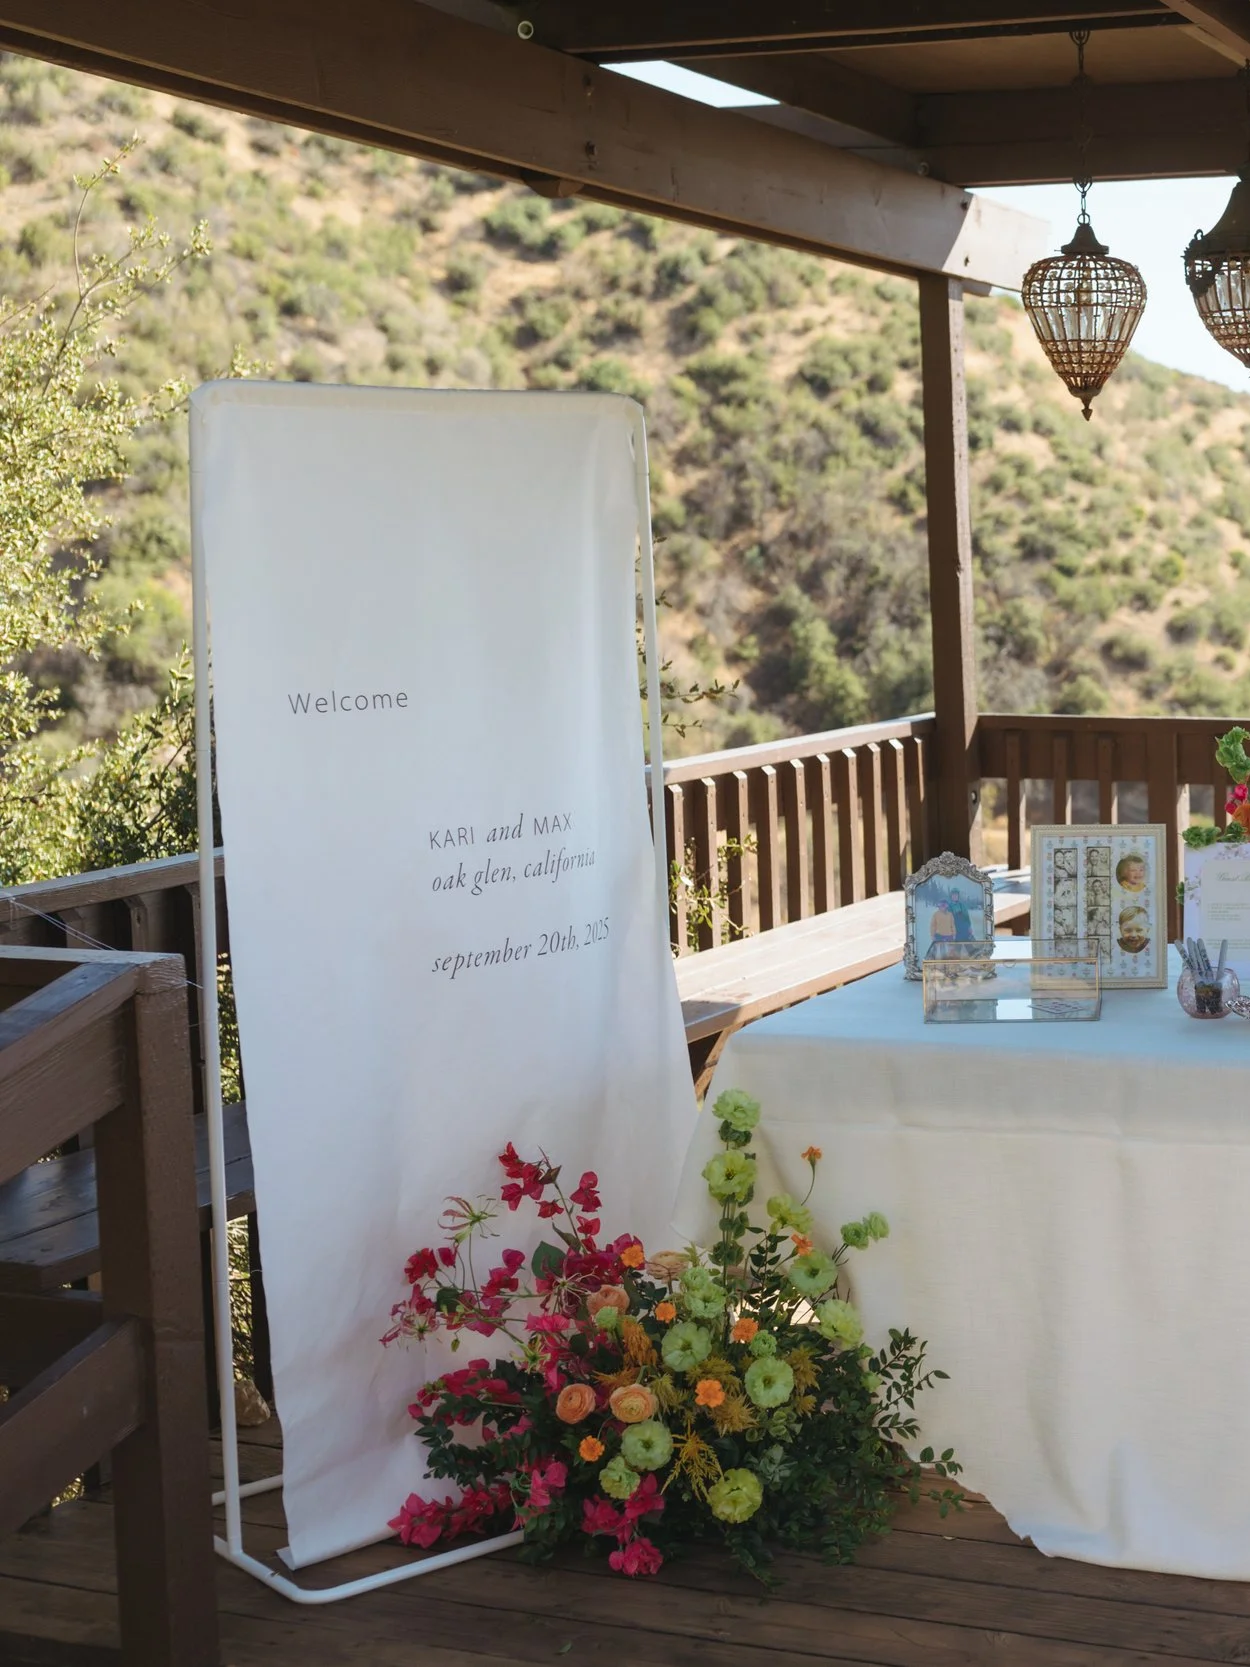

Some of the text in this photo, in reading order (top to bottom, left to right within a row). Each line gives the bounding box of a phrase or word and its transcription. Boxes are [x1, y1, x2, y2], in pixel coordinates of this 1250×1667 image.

[288, 690, 408, 714] Welcome
[429, 812, 573, 850] KARI and MAX
[432, 847, 596, 896] oak glen, california
[431, 917, 610, 980] september 20th, 2025
